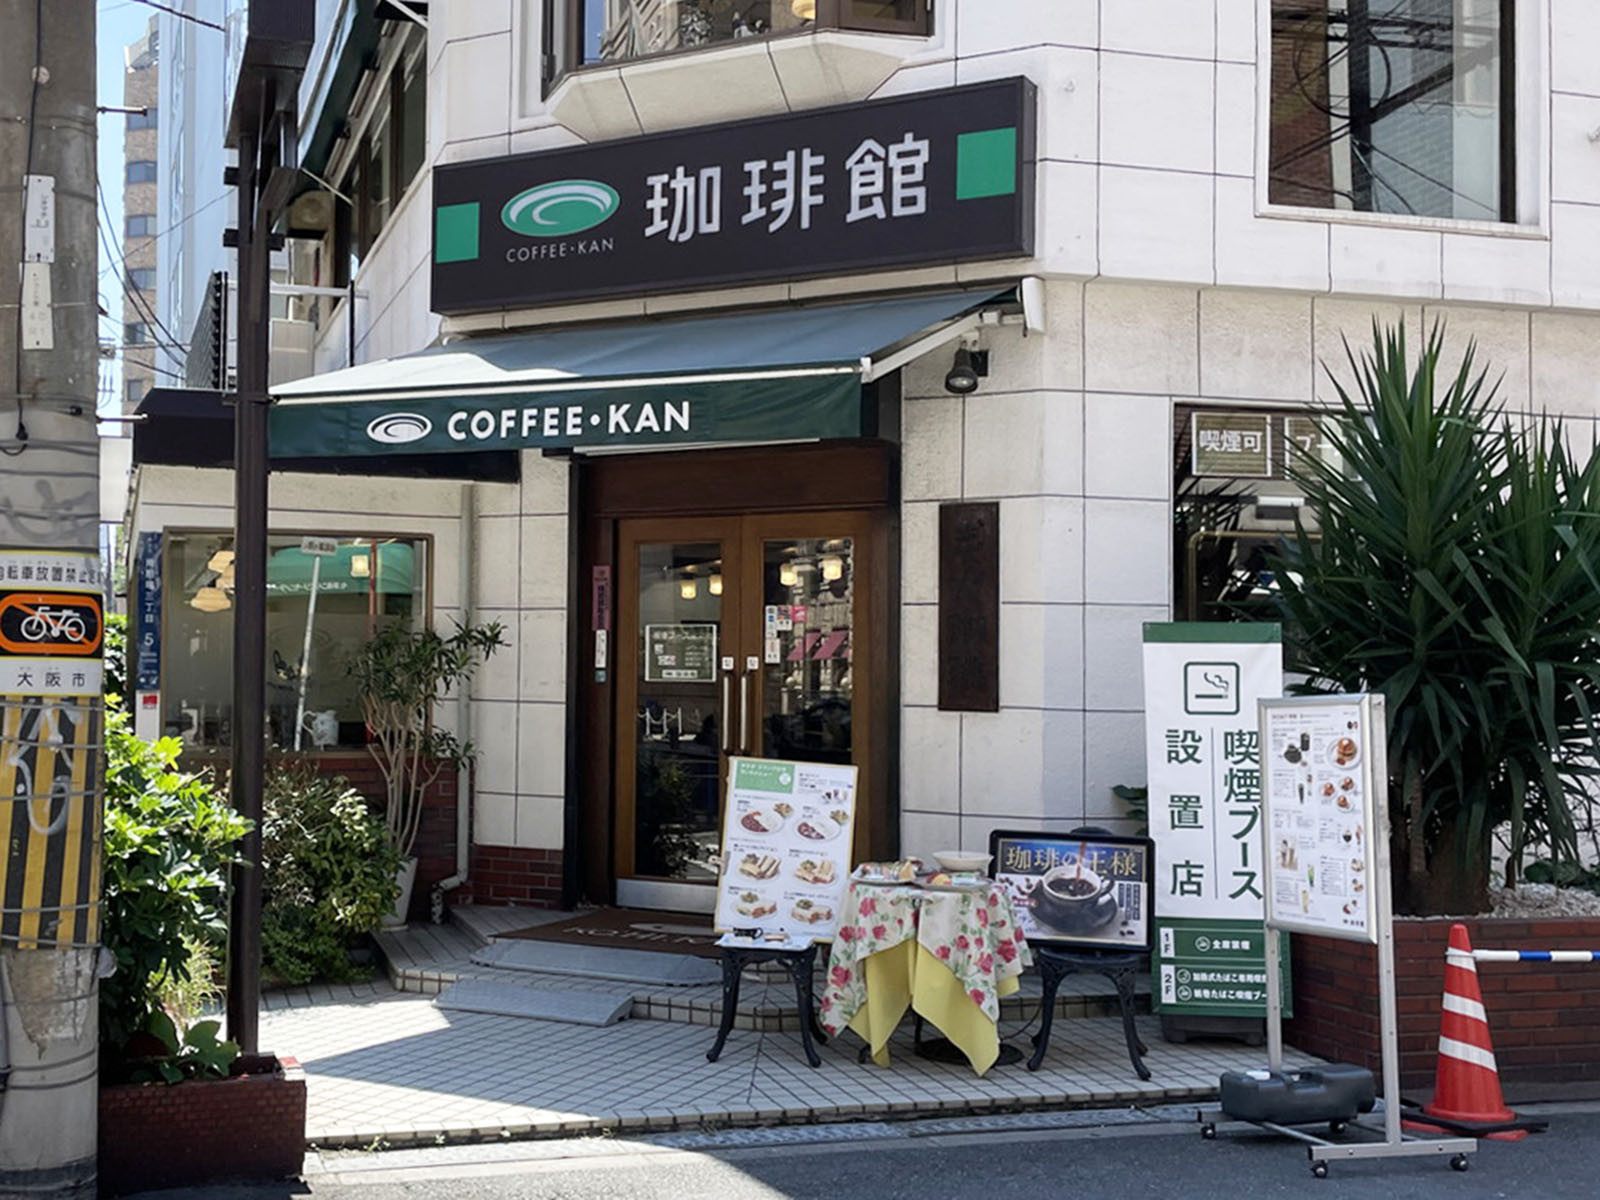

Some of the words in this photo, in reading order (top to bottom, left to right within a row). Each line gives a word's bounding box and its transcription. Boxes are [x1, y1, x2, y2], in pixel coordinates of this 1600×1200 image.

[644, 132, 931, 243] 珈琲館
[1199, 430, 1263, 453] 喫煙可
[17, 672, 86, 687] 大阪市
[1166, 729, 1204, 897] 設置店
[1224, 730, 1263, 900] 喫煙ブース
[1006, 846, 1137, 876] 珈琲の王様
